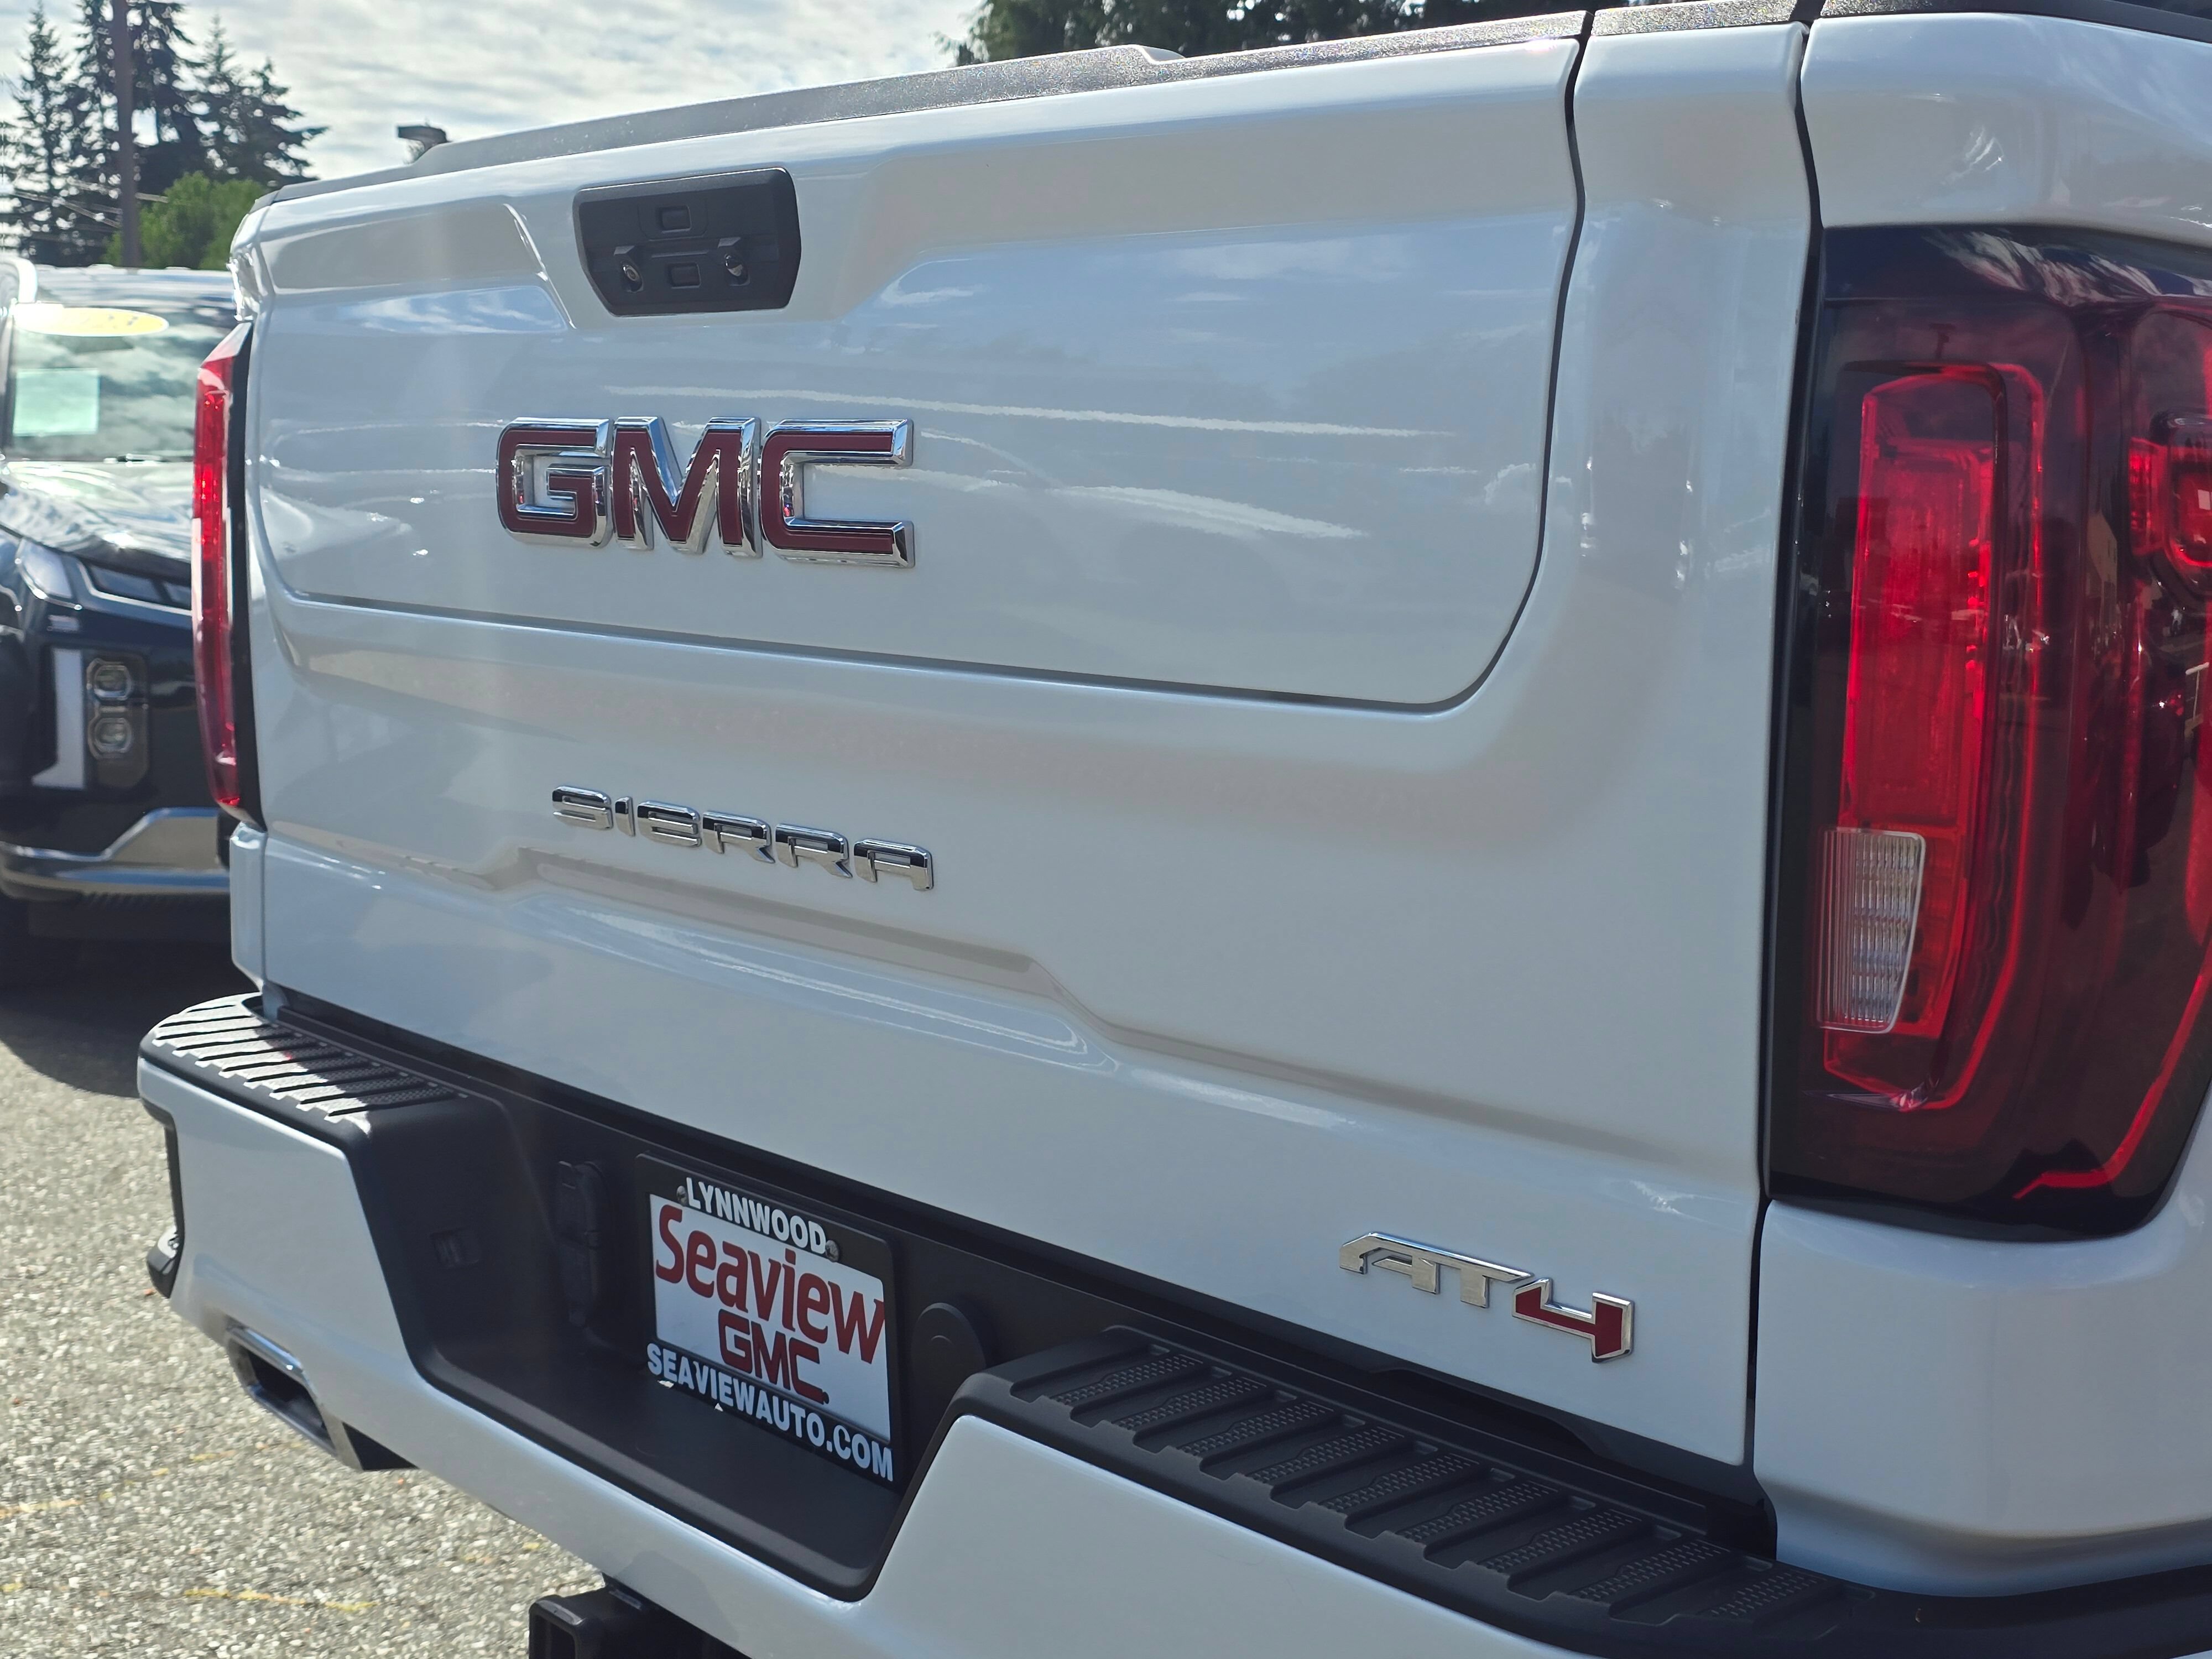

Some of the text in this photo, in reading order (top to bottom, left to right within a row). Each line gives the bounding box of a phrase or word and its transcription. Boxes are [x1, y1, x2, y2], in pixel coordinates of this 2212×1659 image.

[496, 416, 915, 567] GMC
[552, 785, 933, 891] SIERRA
[685, 1177, 827, 1254] LYNNWOOD
[655, 1204, 885, 1364] Seaview
[1339, 1231, 1635, 1363] AT4
[646, 1343, 894, 1481] SEAVIEWAUTO.COM
[718, 1309, 829, 1405] GMC
